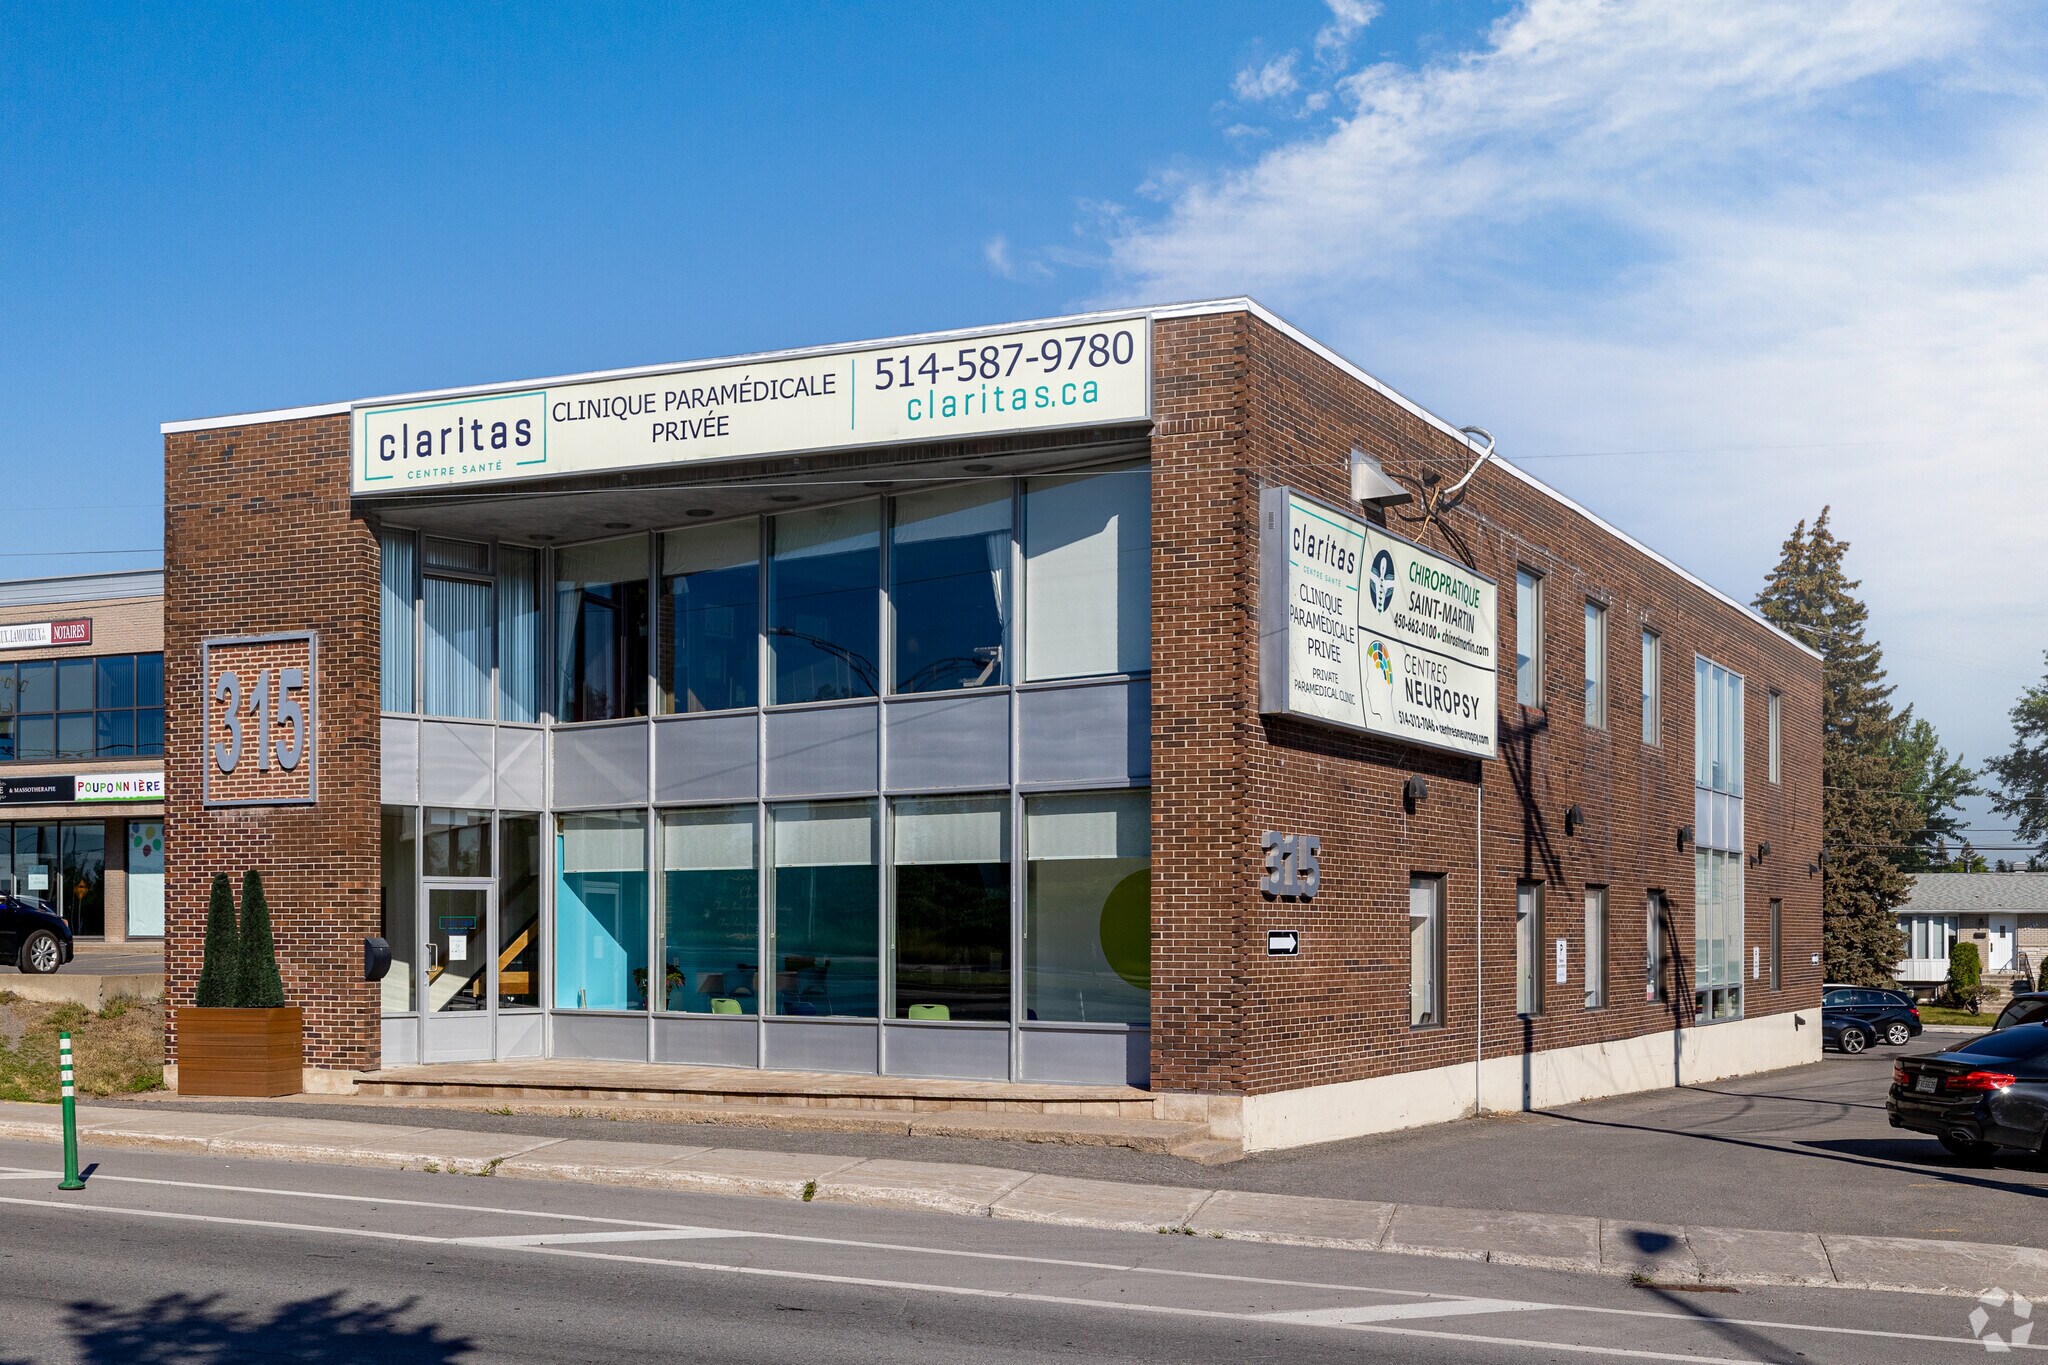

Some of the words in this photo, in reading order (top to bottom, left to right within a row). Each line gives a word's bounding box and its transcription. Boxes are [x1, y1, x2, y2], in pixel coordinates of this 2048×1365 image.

[875, 330, 1134, 390] 514-587-9780
[552, 394, 656, 423] CLINIQUE
[665, 373, 836, 411] PARAMÉDICALE
[907, 380, 1099, 421] claritas.ca
[380, 417, 532, 461] claritas
[652, 410, 729, 443] PRIVÉE
[407, 466, 455, 480] CENTRE
[462, 460, 503, 474] SANTÉ
[1294, 524, 1355, 574] claritas
[1303, 565, 1323, 580] CENTRE
[1409, 561, 1480, 609] CHIROPRATIQUE
[1300, 583, 1342, 615] CLINIQUE
[1409, 591, 1475, 634] SAINT-MARTIN
[54, 624, 85, 640] NOTAIRES
[1290, 604, 1355, 644] PARAMÉDICALE
[1394, 612, 1437, 640] 450-662-0100
[1308, 637, 1341, 663] PRIVÉE
[1404, 653, 1447, 684] CENTRES
[1294, 679, 1338, 700] PARAMEDICAL
[1340, 690, 1356, 705] CLINIC
[1313, 668, 1339, 684] PRIVATE
[1405, 677, 1479, 720] NEUROPSY
[215, 668, 304, 773] 315
[1261, 831, 1320, 898] 315
